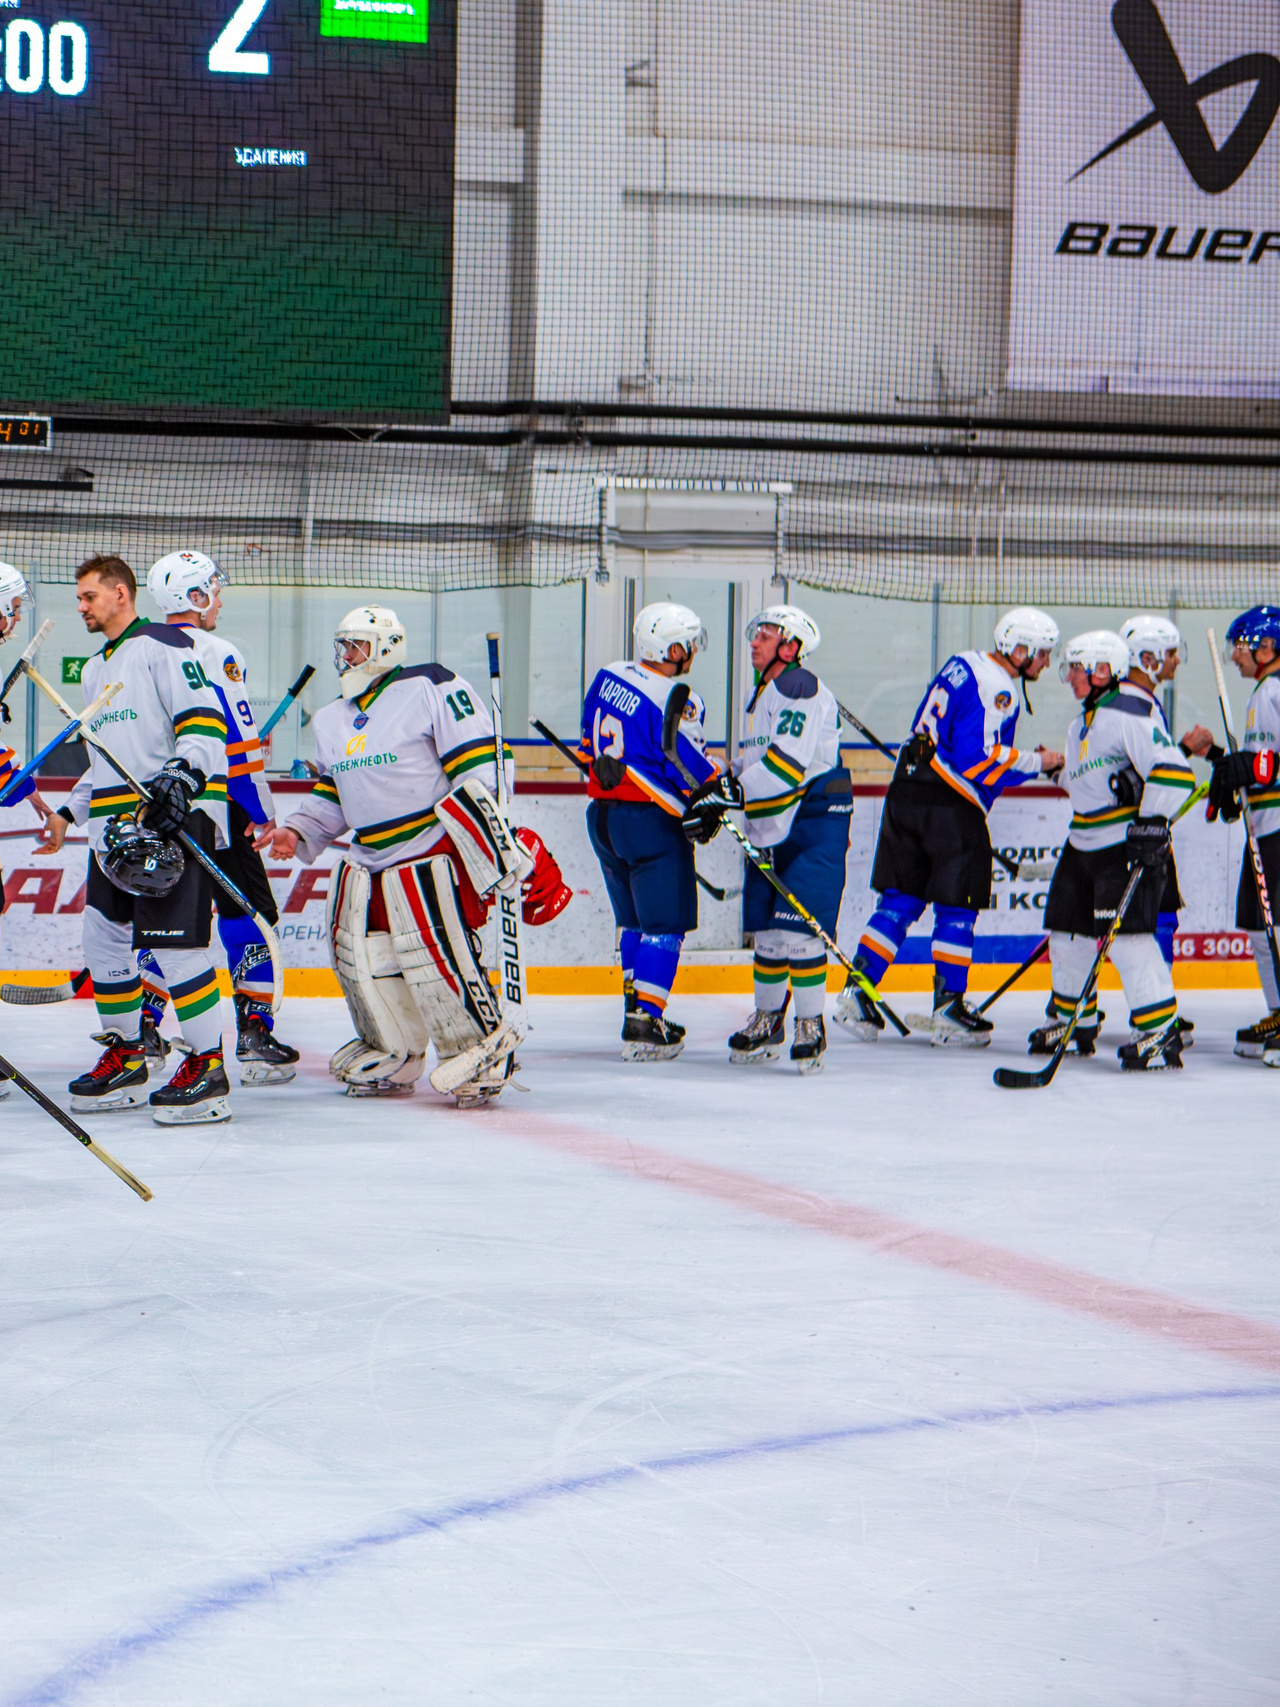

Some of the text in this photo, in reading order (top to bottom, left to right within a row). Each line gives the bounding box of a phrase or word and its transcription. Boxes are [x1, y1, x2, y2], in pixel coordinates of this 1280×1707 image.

[20, 422, 39, 435] 01
[445, 688, 476, 722] 19
[598, 676, 642, 717] КАРПОВ
[775, 709, 807, 738] 26
[476, 796, 512, 852] CCM
[500, 894, 522, 1005] BAUER
